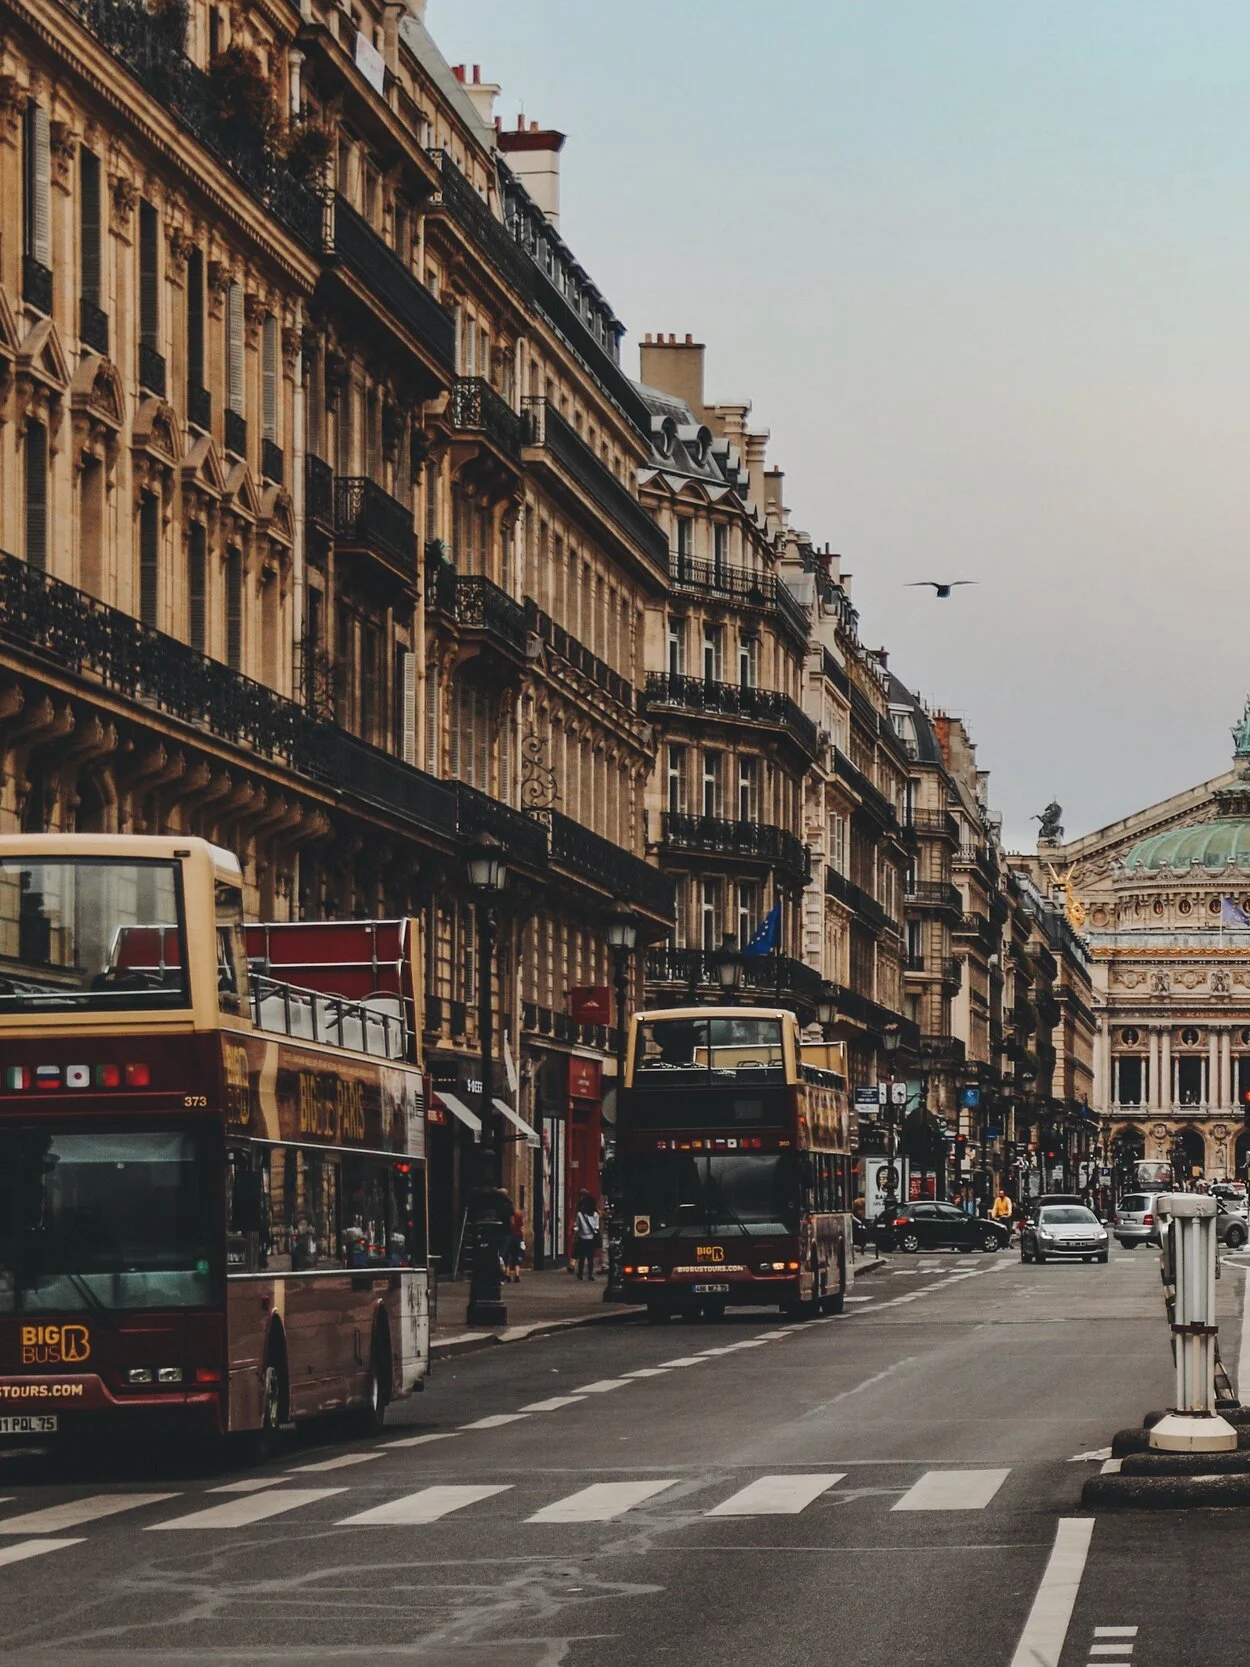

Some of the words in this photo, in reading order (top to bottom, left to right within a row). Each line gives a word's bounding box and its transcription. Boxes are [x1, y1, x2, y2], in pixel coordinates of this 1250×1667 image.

[184, 1096, 207, 1107] 373
[299, 1072, 317, 1133] BIG
[336, 1079, 365, 1139] PARIS
[697, 1246, 712, 1255] BIG
[677, 1265, 744, 1273] BIGBUSTOURS.COM
[22, 1325, 60, 1346] BIG
[22, 1346, 61, 1364] BUS
[40, 1415, 54, 1430] 75
